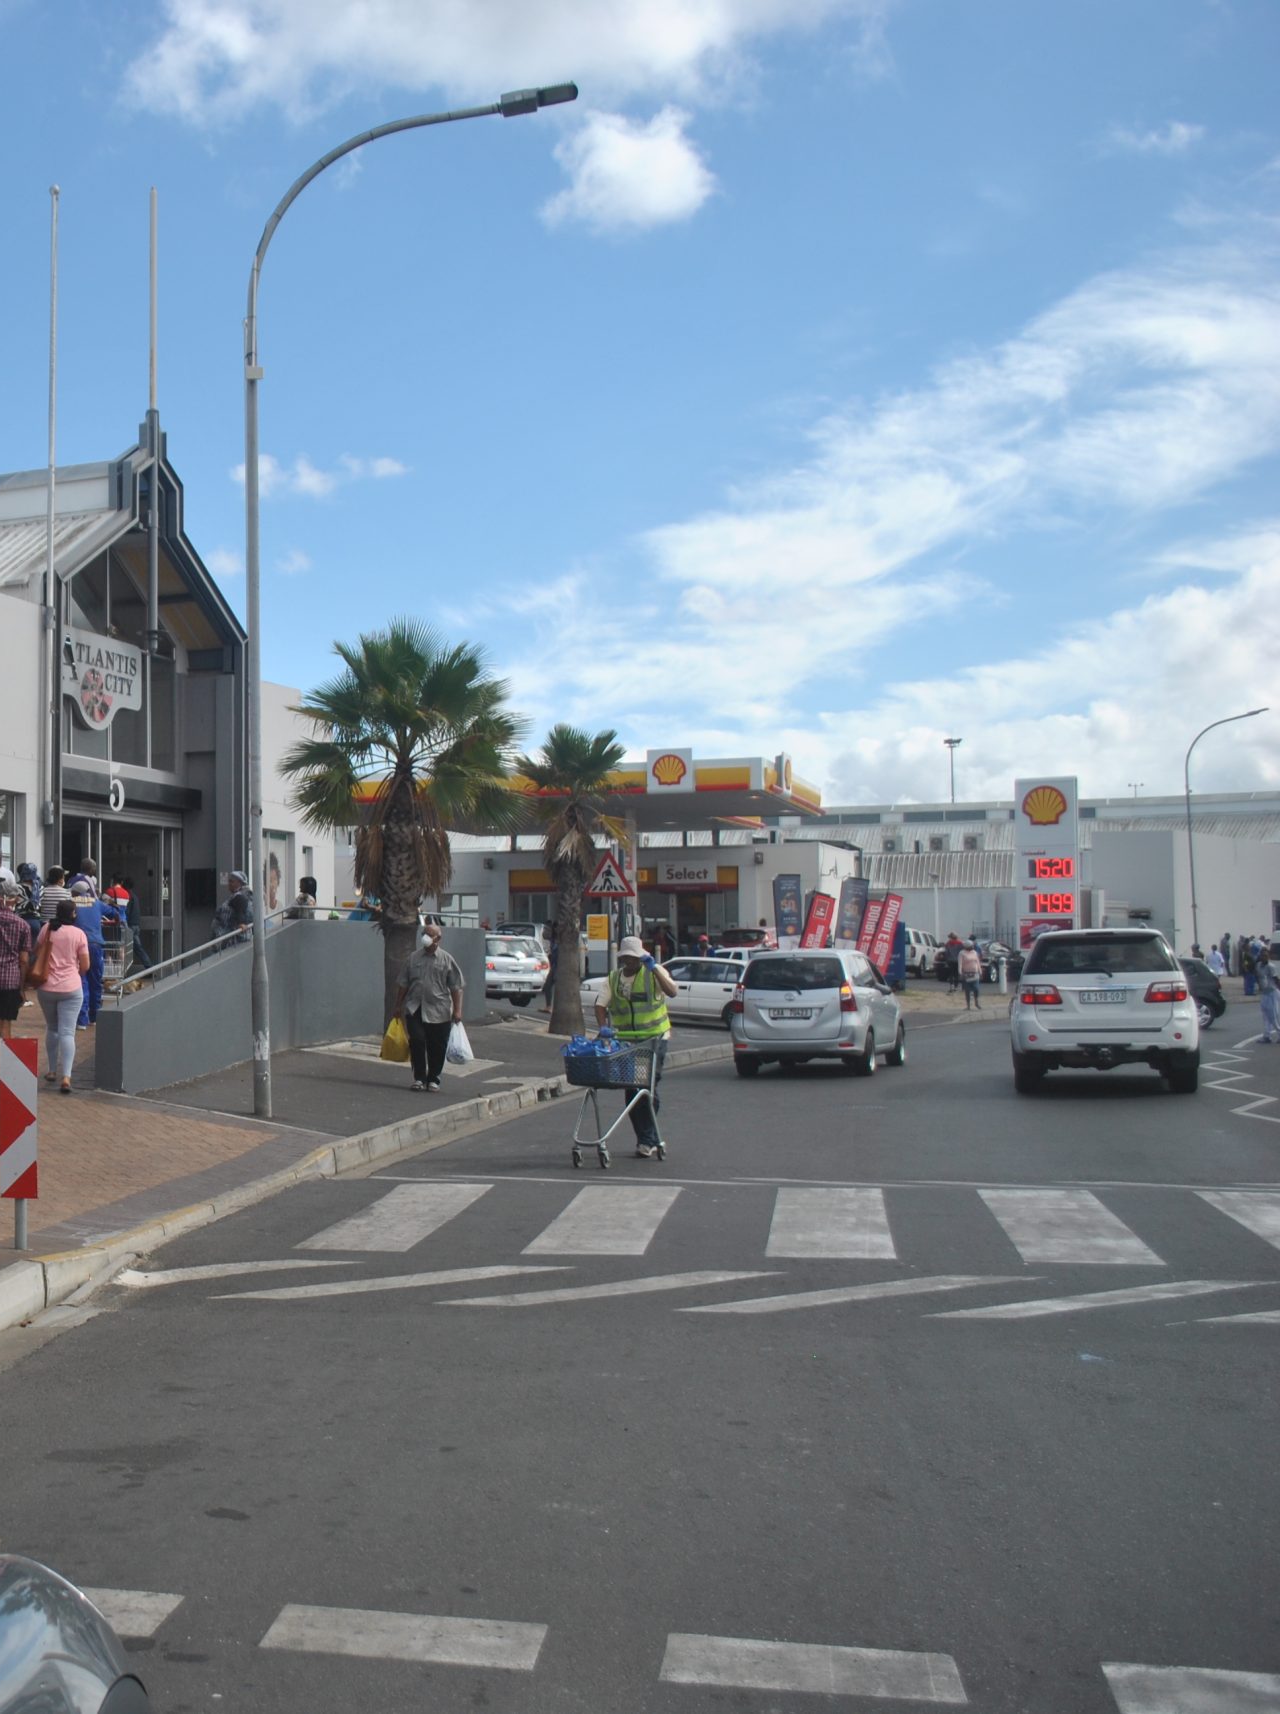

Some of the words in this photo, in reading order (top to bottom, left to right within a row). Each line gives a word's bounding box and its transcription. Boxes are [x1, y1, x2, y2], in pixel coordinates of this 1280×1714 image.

[62, 634, 138, 680] ATLANTIS
[104, 673, 133, 696] CITY
[666, 867, 709, 880] Select
